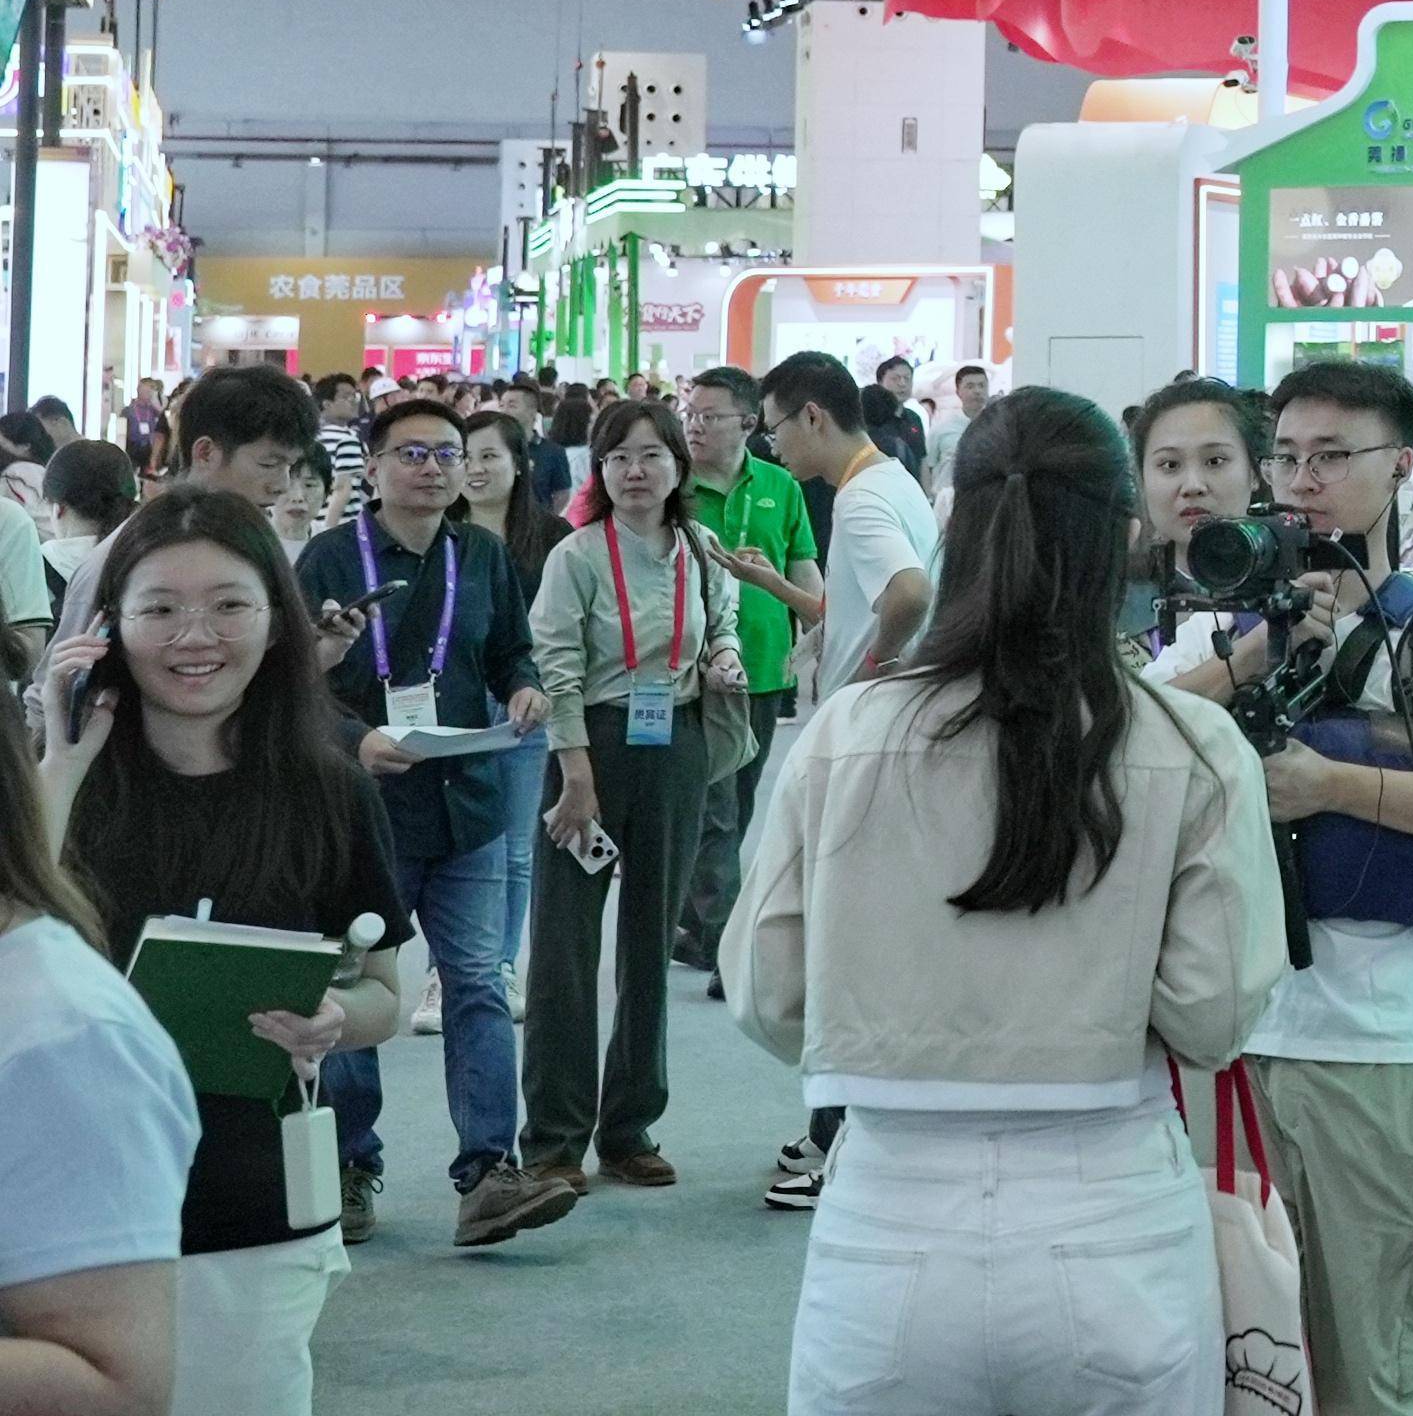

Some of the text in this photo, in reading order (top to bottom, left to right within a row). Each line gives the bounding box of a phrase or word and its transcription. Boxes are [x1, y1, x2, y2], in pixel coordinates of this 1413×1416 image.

[269, 274, 406, 300] 农食莞品区
